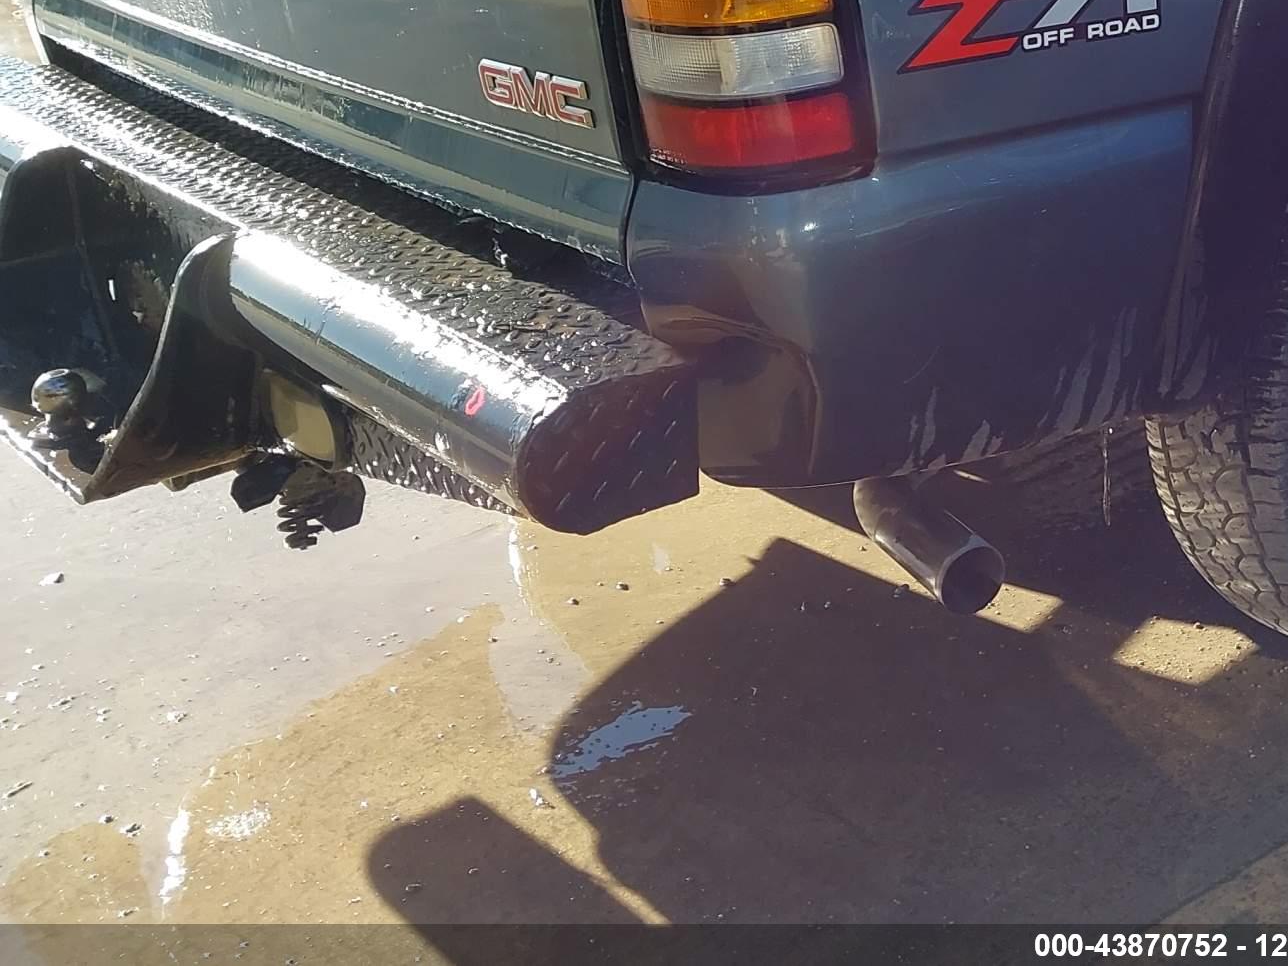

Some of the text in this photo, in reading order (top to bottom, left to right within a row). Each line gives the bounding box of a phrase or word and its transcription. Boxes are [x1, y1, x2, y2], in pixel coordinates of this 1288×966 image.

[1022, 13, 1161, 51] OFF ROAD
[478, 59, 594, 129] GMC
